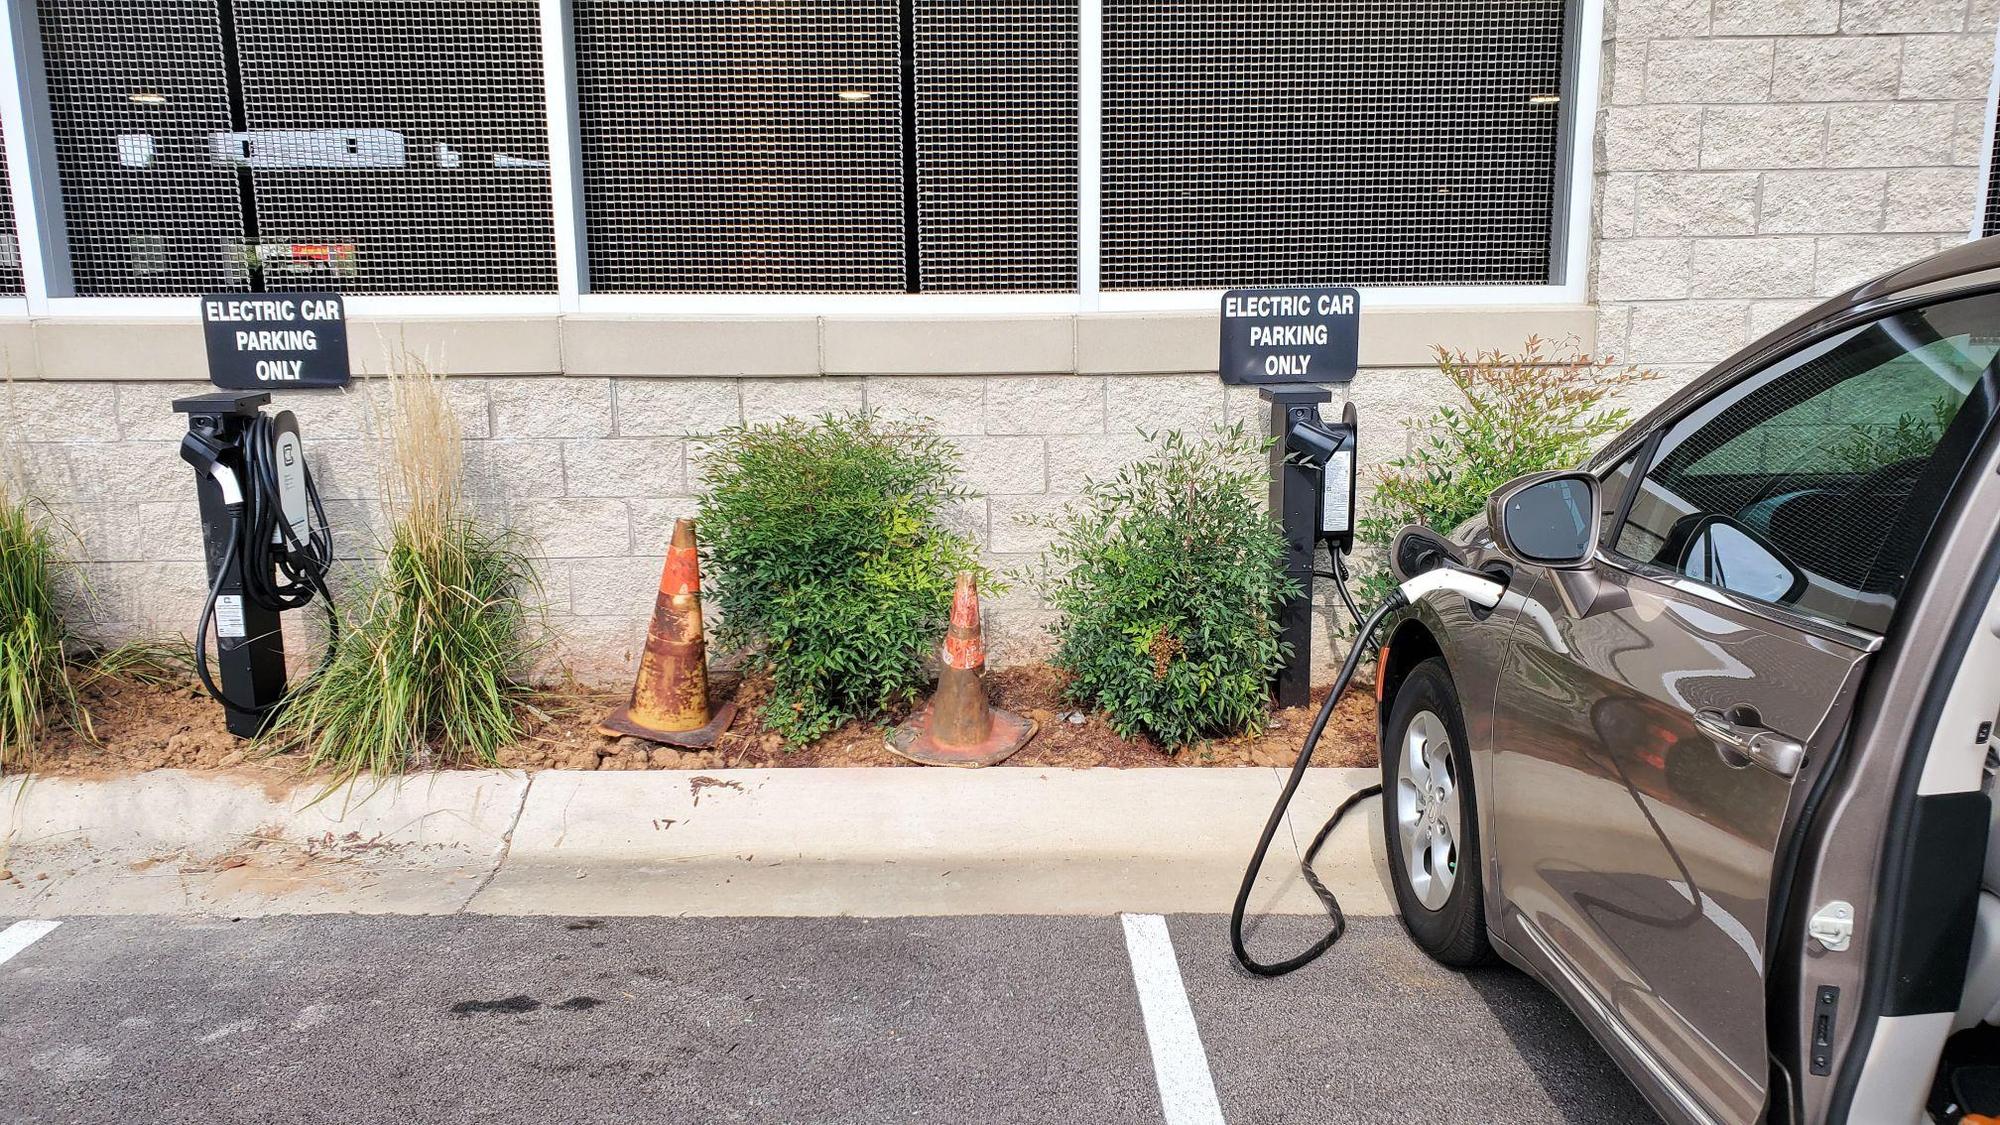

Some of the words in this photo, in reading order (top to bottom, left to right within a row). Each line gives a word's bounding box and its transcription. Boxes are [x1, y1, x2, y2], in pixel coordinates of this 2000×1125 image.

[206, 301, 296, 321] ELECTRIC
[300, 300, 341, 321] CAR
[1225, 295, 1311, 318] ELECTRIC
[1317, 294, 1355, 316] CAR
[235, 330, 318, 351] PARKING
[1250, 325, 1328, 347] PARKING
[255, 360, 304, 381] ONLY
[1264, 354, 1312, 376] ONLY
